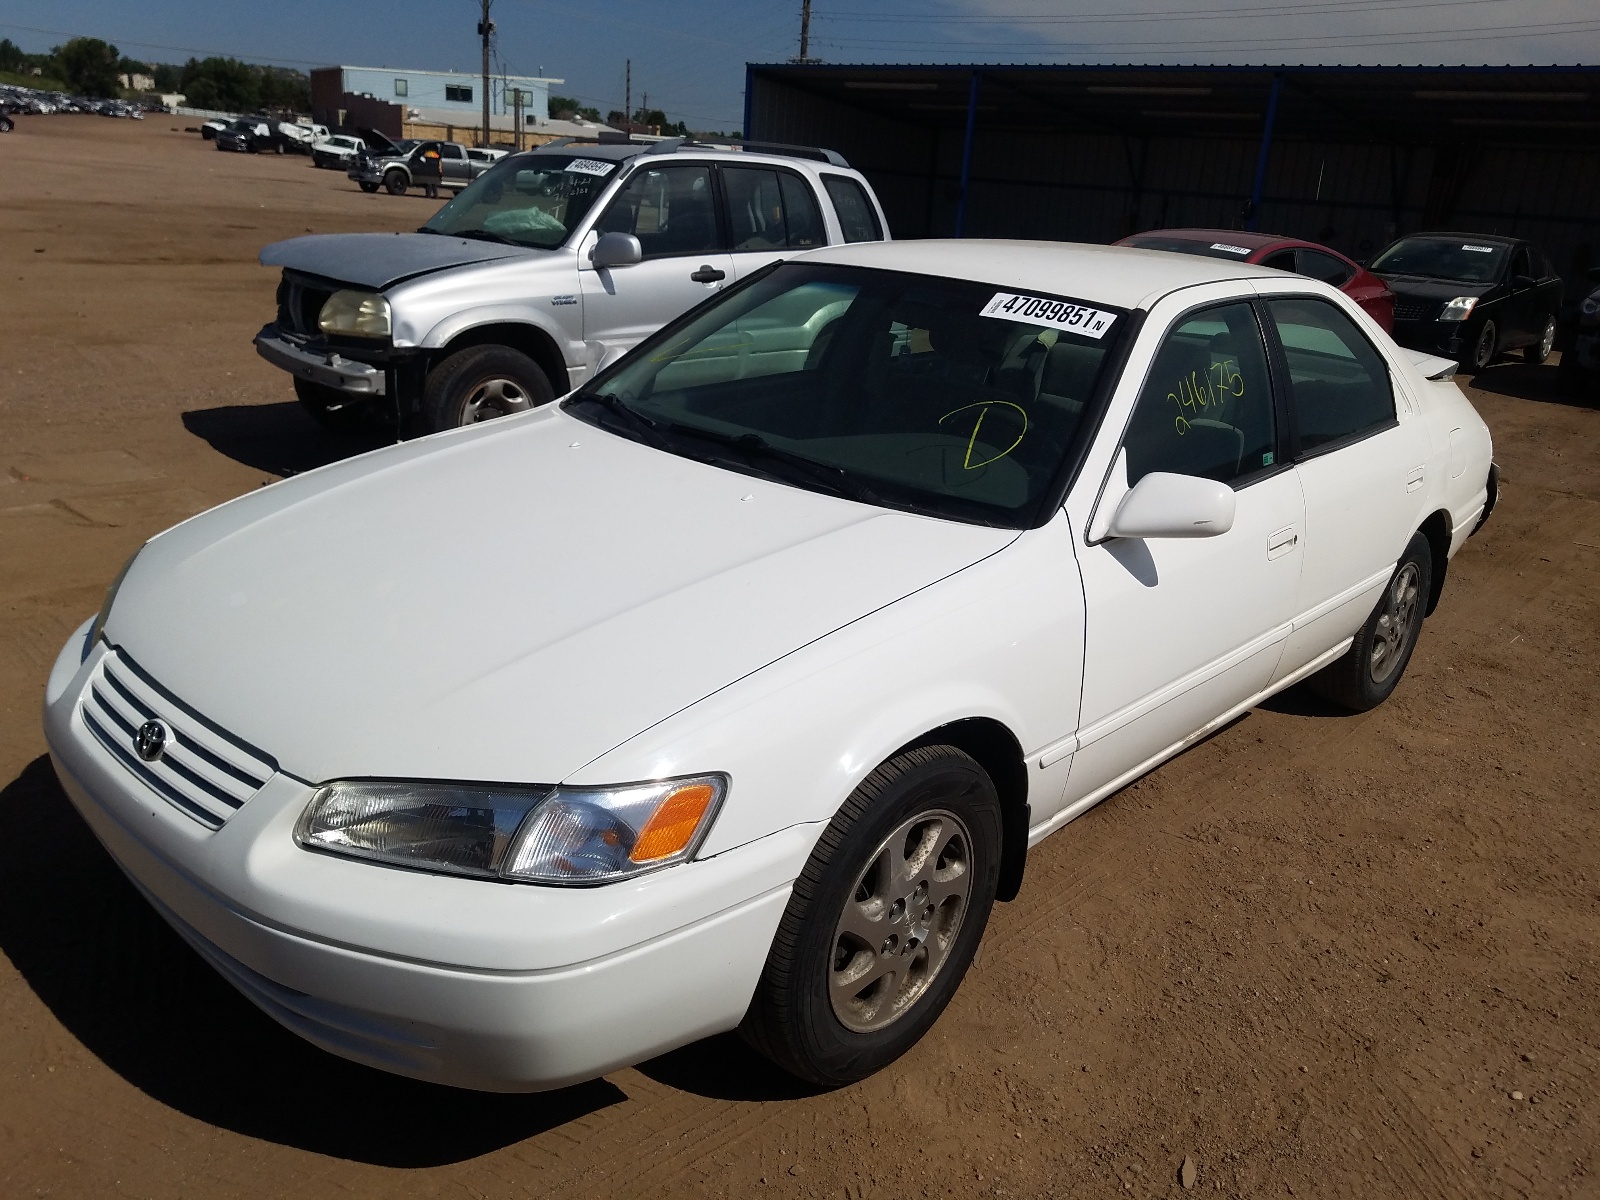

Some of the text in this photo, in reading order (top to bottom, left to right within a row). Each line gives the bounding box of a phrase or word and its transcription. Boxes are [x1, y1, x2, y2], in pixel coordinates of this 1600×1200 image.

[1002, 296, 1098, 329] 47099851
[1092, 320, 1106, 332] N
[938, 400, 1028, 470] D
